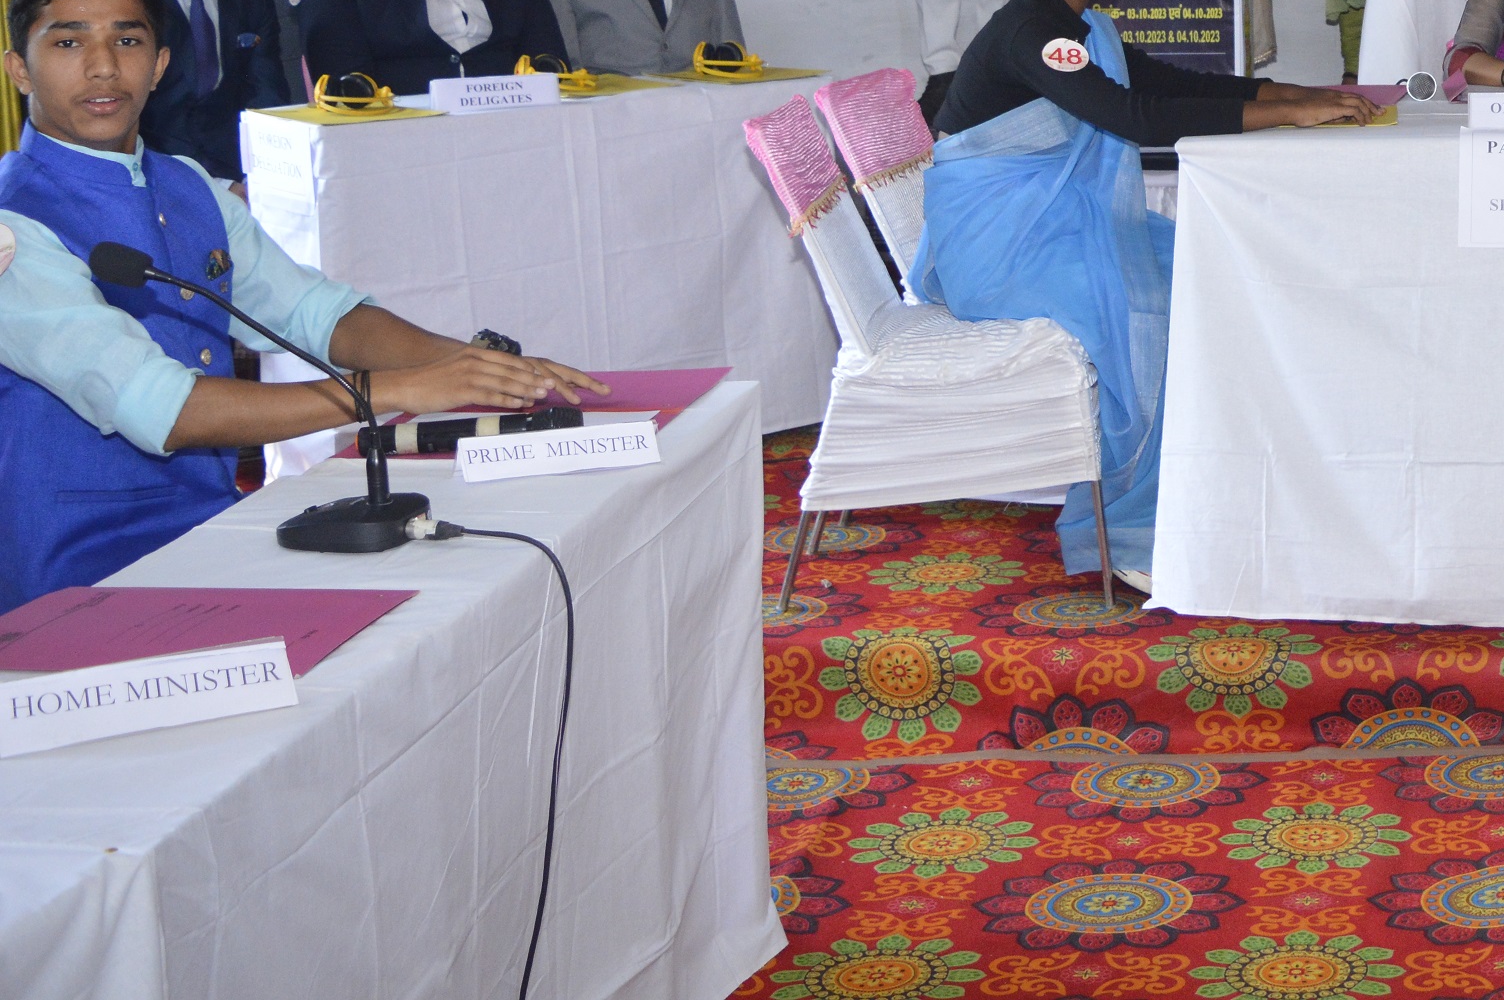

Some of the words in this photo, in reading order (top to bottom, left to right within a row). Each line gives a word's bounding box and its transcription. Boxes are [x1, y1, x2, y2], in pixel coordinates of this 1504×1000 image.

[1168, 30, 1175, 43] &
[1177, 30, 1220, 43] 04.10.2023
[1048, 47, 1083, 65] 48
[466, 81, 524, 93] FOREIGN
[460, 94, 533, 107] DELIGATES
[467, 444, 535, 464] PRIME
[545, 434, 649, 459] MINISTER
[10, 683, 116, 719] HOME
[125, 660, 283, 703] MINISTER
